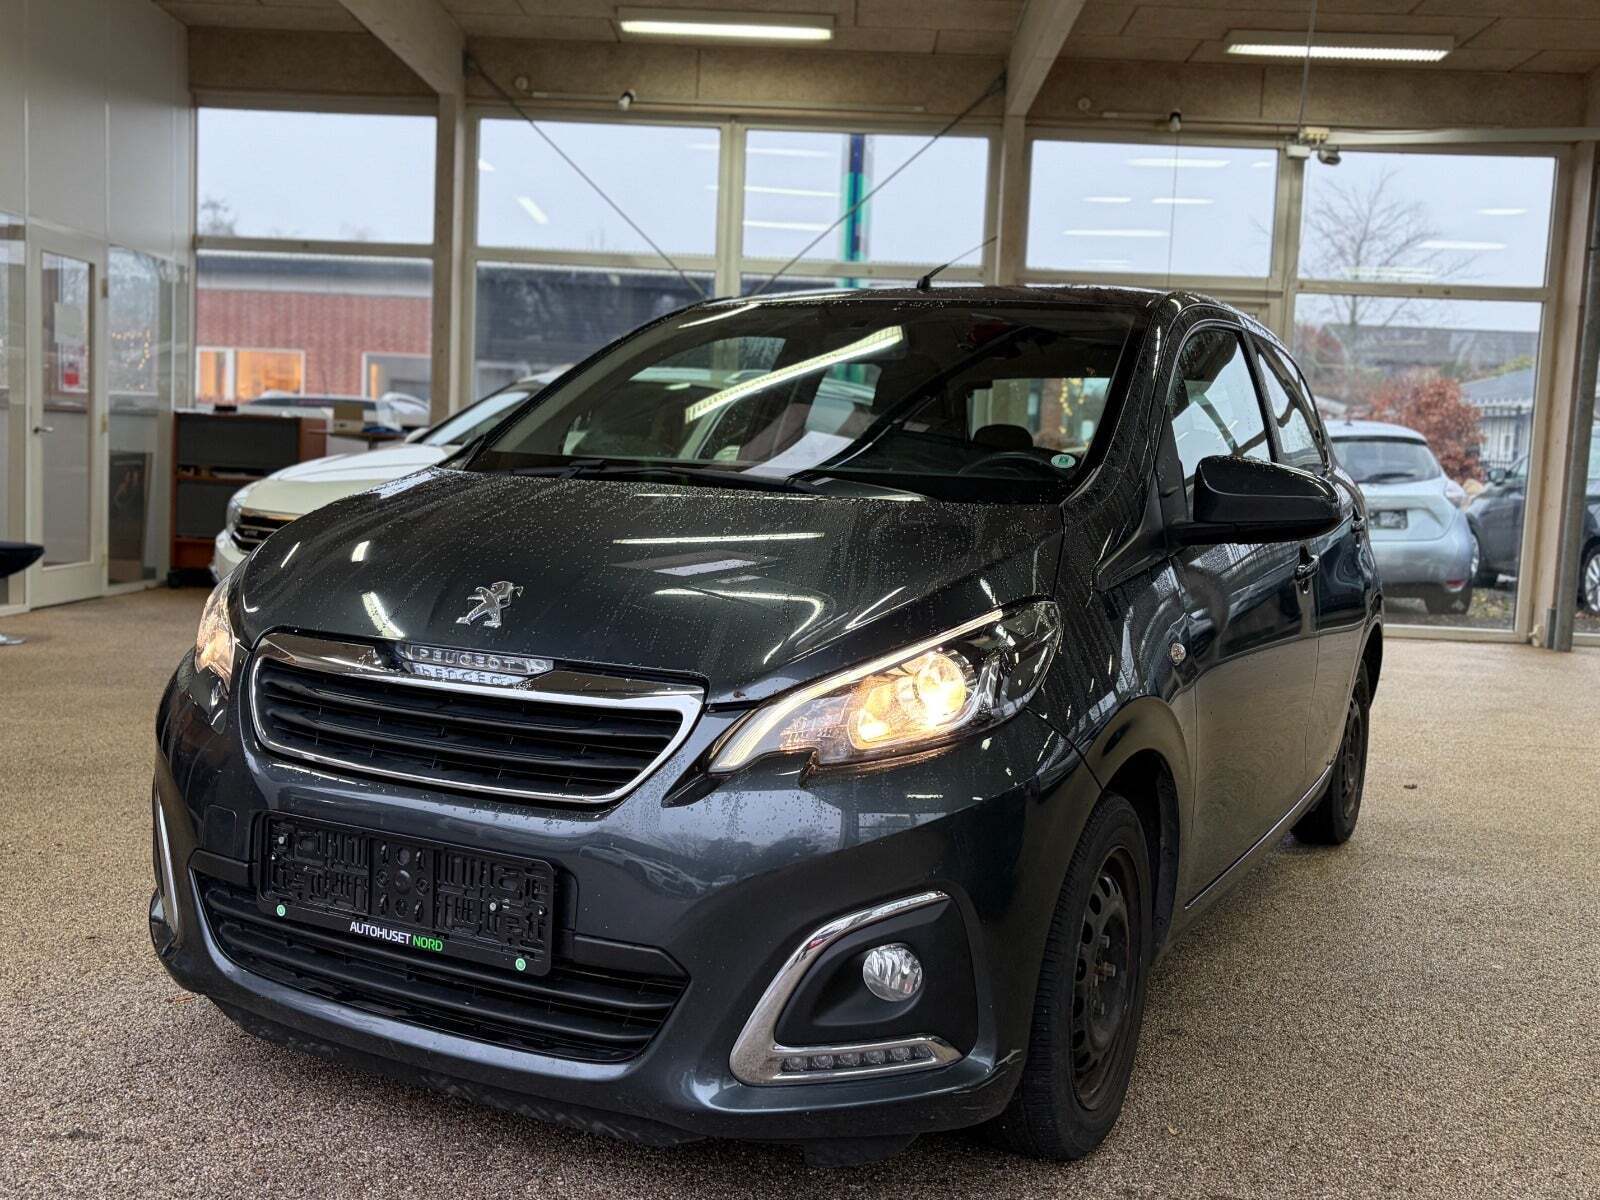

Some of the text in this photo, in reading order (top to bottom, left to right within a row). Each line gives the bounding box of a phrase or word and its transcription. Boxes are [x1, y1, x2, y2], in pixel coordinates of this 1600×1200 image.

[419, 649, 516, 671] PEUGEOT
[349, 921, 444, 952] AUTOHUSET NORD
